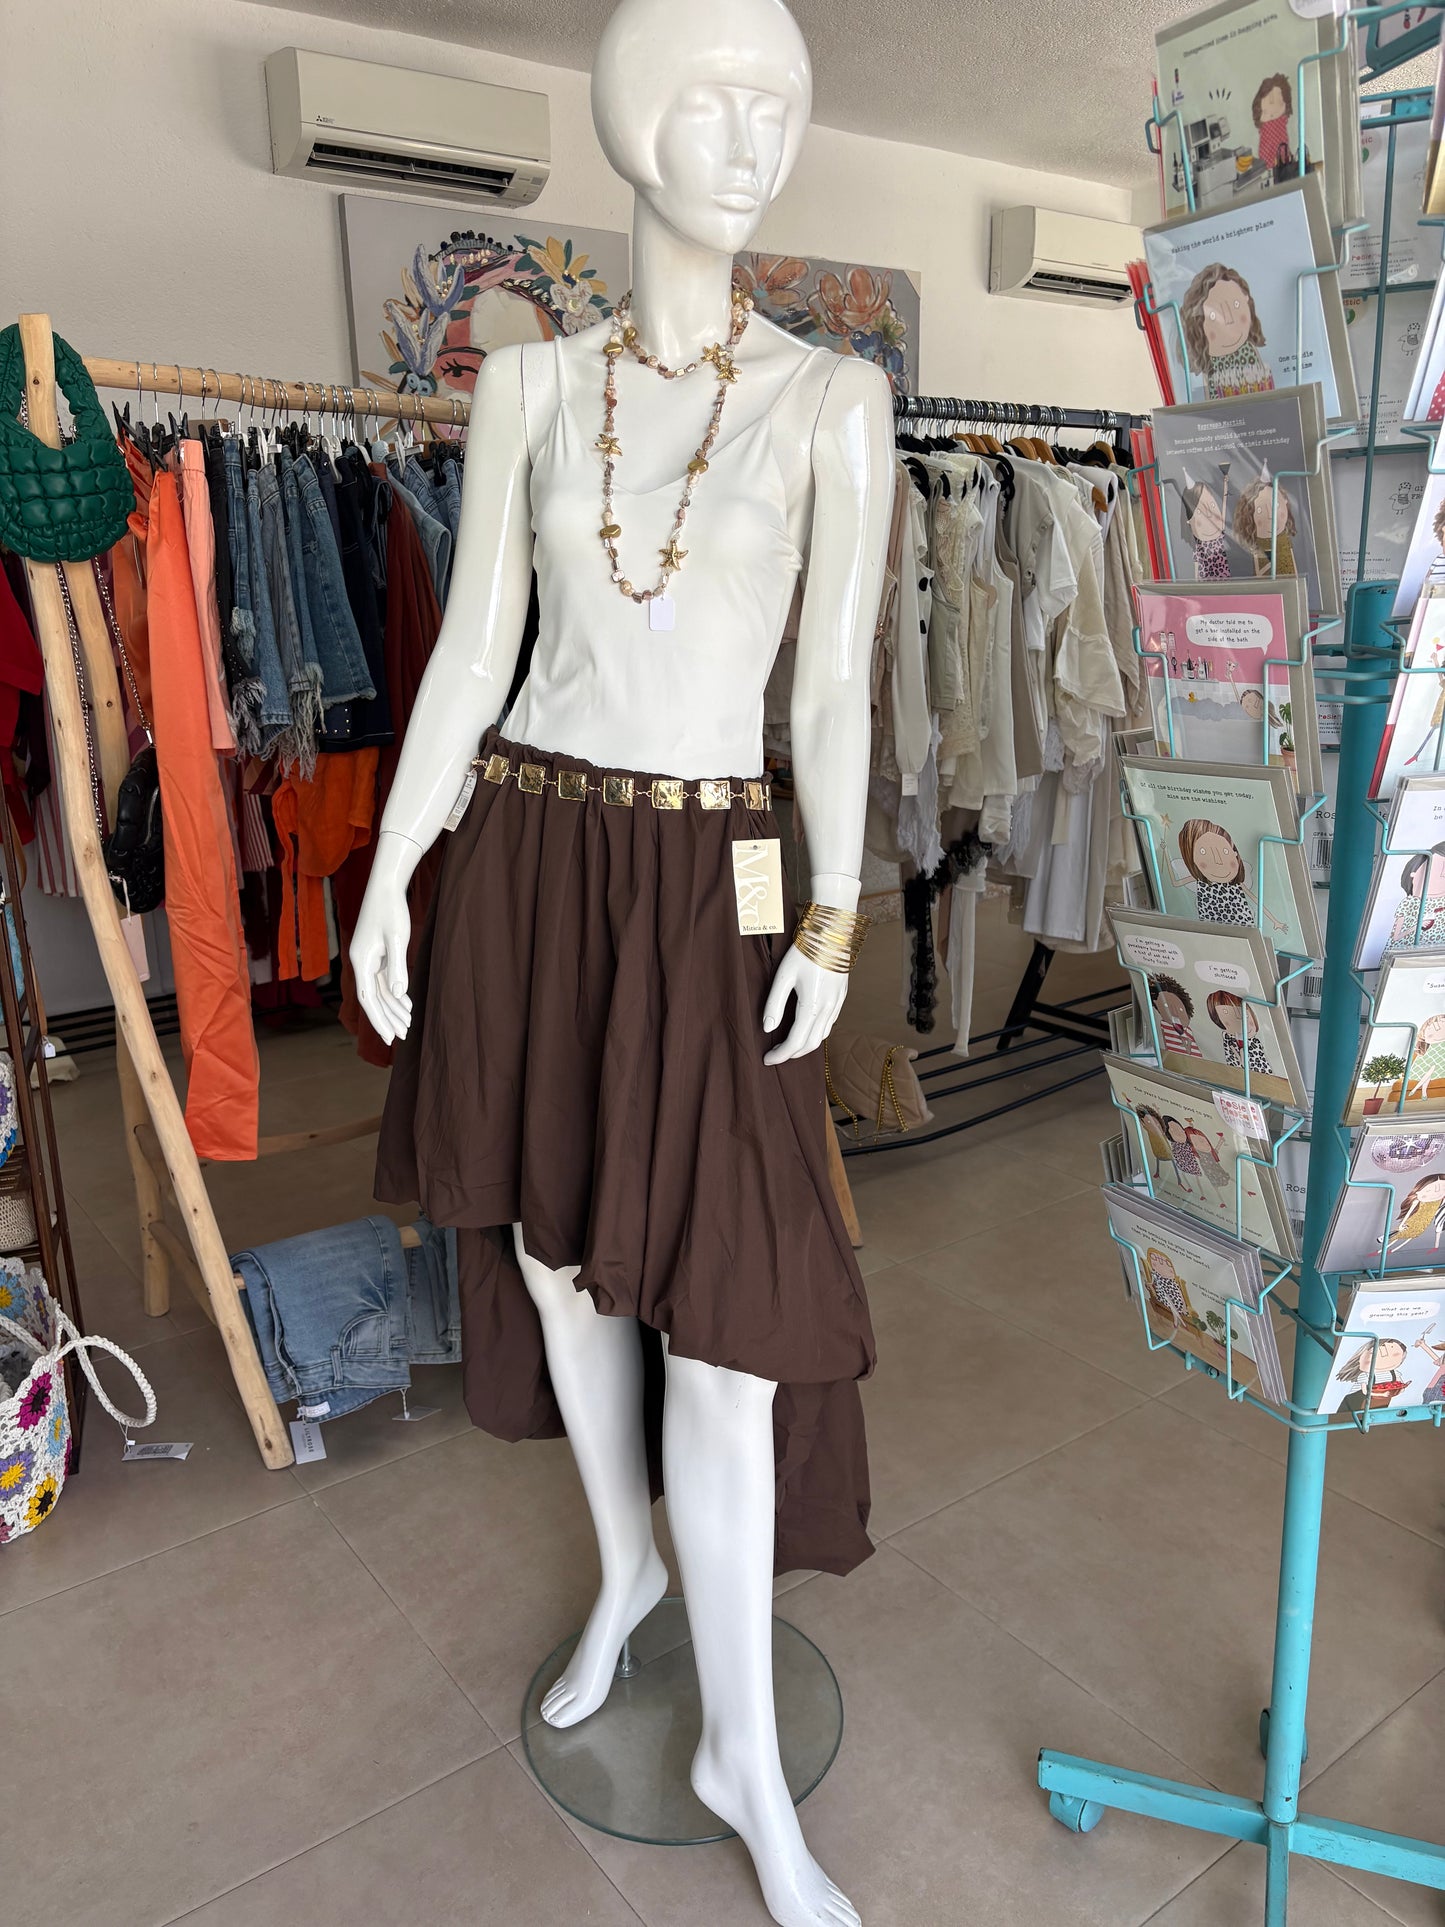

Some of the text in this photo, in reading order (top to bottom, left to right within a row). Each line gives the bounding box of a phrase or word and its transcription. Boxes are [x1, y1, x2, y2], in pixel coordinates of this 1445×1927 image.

[1191, 240, 1201, 249] the
[1202, 234, 1220, 246] world
[1225, 226, 1254, 240] brighter
[1255, 219, 1274, 232] place
[1291, 351, 1314, 361] cdle
[1222, 418, 1246, 428] Martini
[1195, 436, 1213, 444] nobody
[1214, 432, 1233, 441] should
[1256, 428, 1276, 436] choose
[1186, 446, 1203, 454] coffee
[1214, 442, 1236, 451] alcohol
[1245, 439, 1262, 447] their
[1263, 437, 1290, 446] birthday
[1167, 785, 1192, 794] birthday
[1192, 787, 1212, 795] wishes
[1235, 792, 1254, 800] today,
